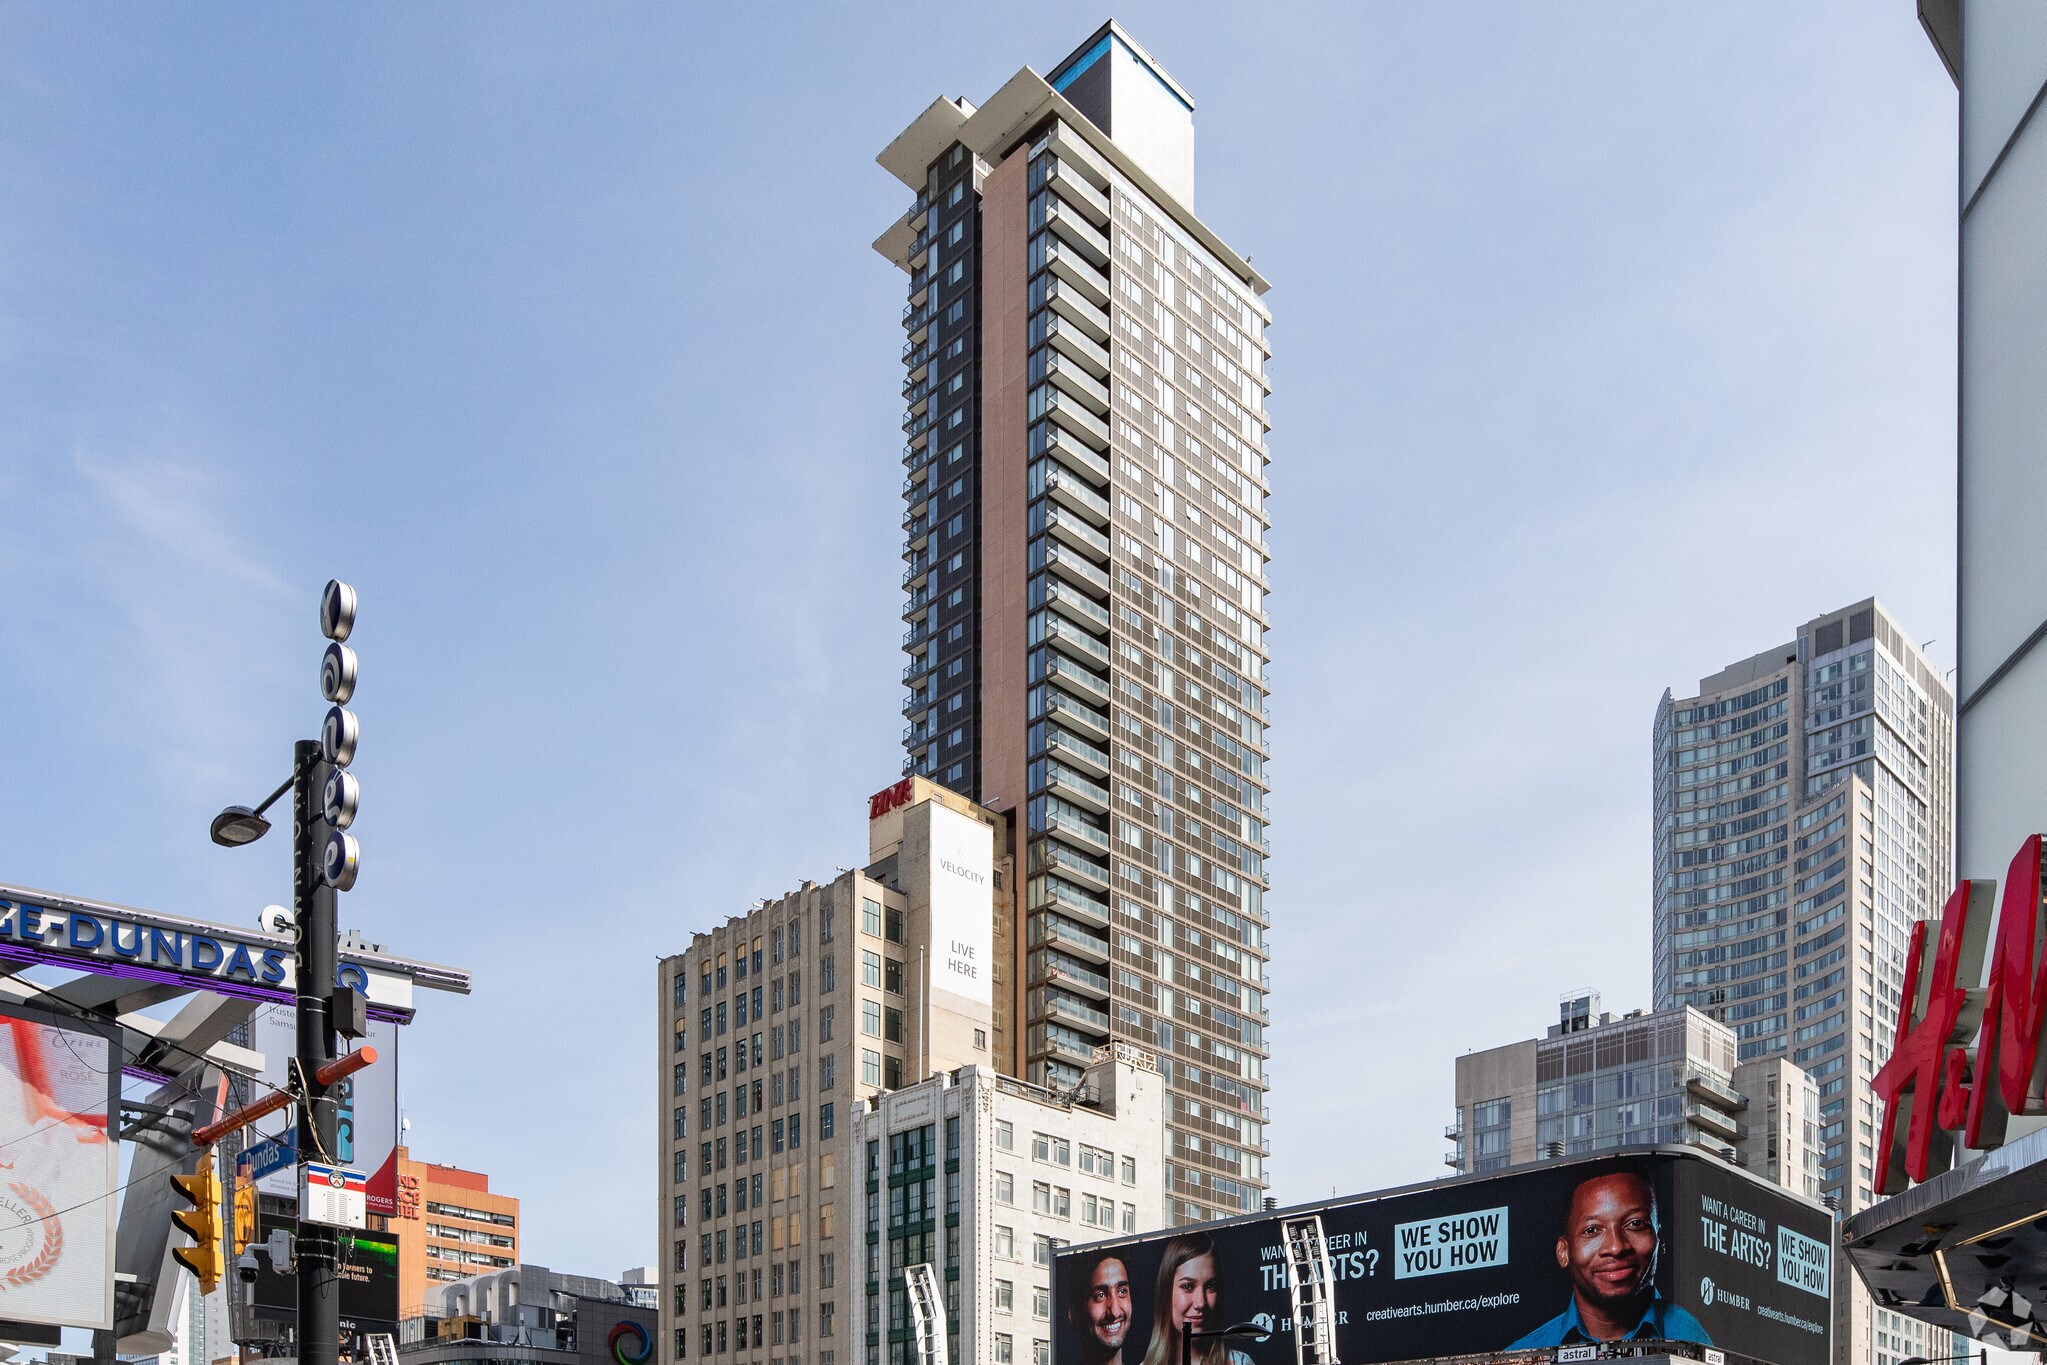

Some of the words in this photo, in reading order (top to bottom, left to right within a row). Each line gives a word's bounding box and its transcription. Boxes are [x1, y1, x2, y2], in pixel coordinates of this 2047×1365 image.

[940, 858, 985, 885] VELOCITY
[951, 940, 975, 960] LIVE
[948, 958, 977, 980] HERE
[246, 1143, 280, 1174] Dundas
[366, 1194, 393, 1205] ROGERS
[1701, 1194, 1722, 1217] WANT
[1723, 1204, 1728, 1220] A
[1730, 1206, 1757, 1231] CAREER
[1758, 1218, 1765, 1234] IN
[1261, 1244, 1287, 1261] WAN
[1354, 1230, 1367, 1247] IN
[1401, 1224, 1431, 1249] WE
[1437, 1213, 1500, 1244] SHOW
[1701, 1216, 1727, 1254] THE
[1730, 1229, 1771, 1270] ARTS?
[1403, 1248, 1442, 1274] YOU
[1450, 1239, 1499, 1267] HOW
[1781, 1232, 1796, 1257] WE
[1798, 1239, 1826, 1269] SHOW
[1260, 1263, 1292, 1291] TH
[1782, 1257, 1801, 1283] YOU
[1803, 1265, 1825, 1292] HOW
[1366, 1292, 1520, 1322] creativearts.humber.ca/explore
[1717, 1288, 1751, 1311] HUMBER
[1281, 1310, 1349, 1332] HMR
[1757, 1305, 1824, 1335] creativearts.humber.ca/explore
[1563, 1347, 1591, 1360] astral
[1707, 1351, 1722, 1363] astral
